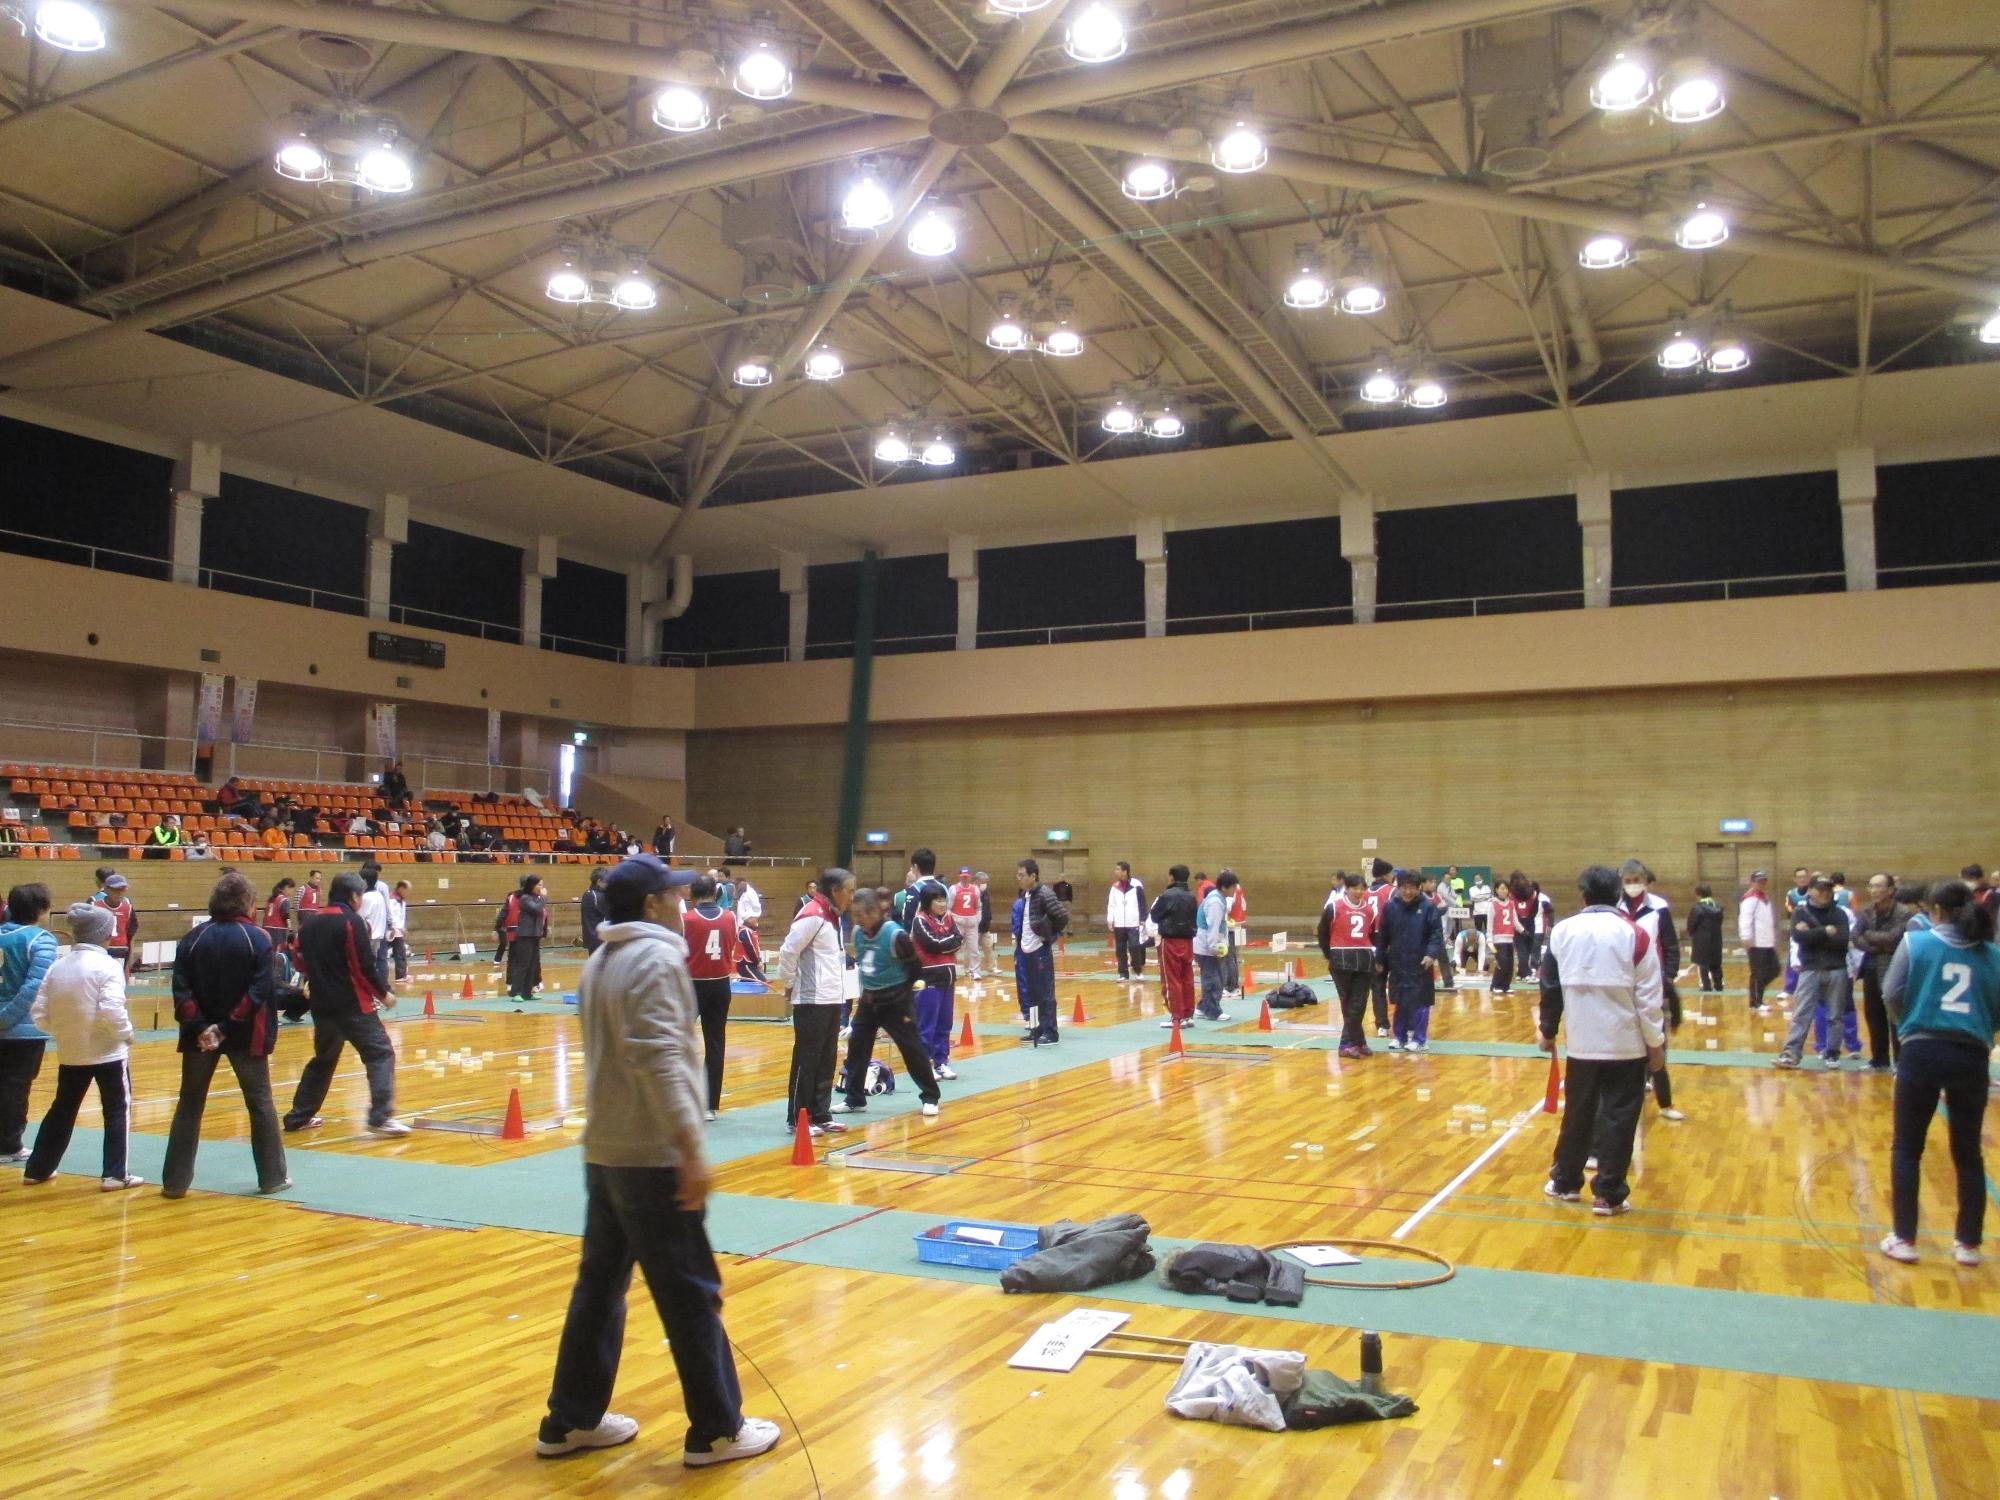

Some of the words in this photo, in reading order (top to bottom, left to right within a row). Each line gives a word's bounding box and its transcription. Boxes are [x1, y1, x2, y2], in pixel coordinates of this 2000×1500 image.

[312, 892, 317, 904] 1
[962, 894, 971, 909] 2
[1350, 915, 1364, 938] 2
[1502, 909, 1511, 925] 2
[705, 929, 721, 960] 4
[1941, 962, 1971, 1014] 2
